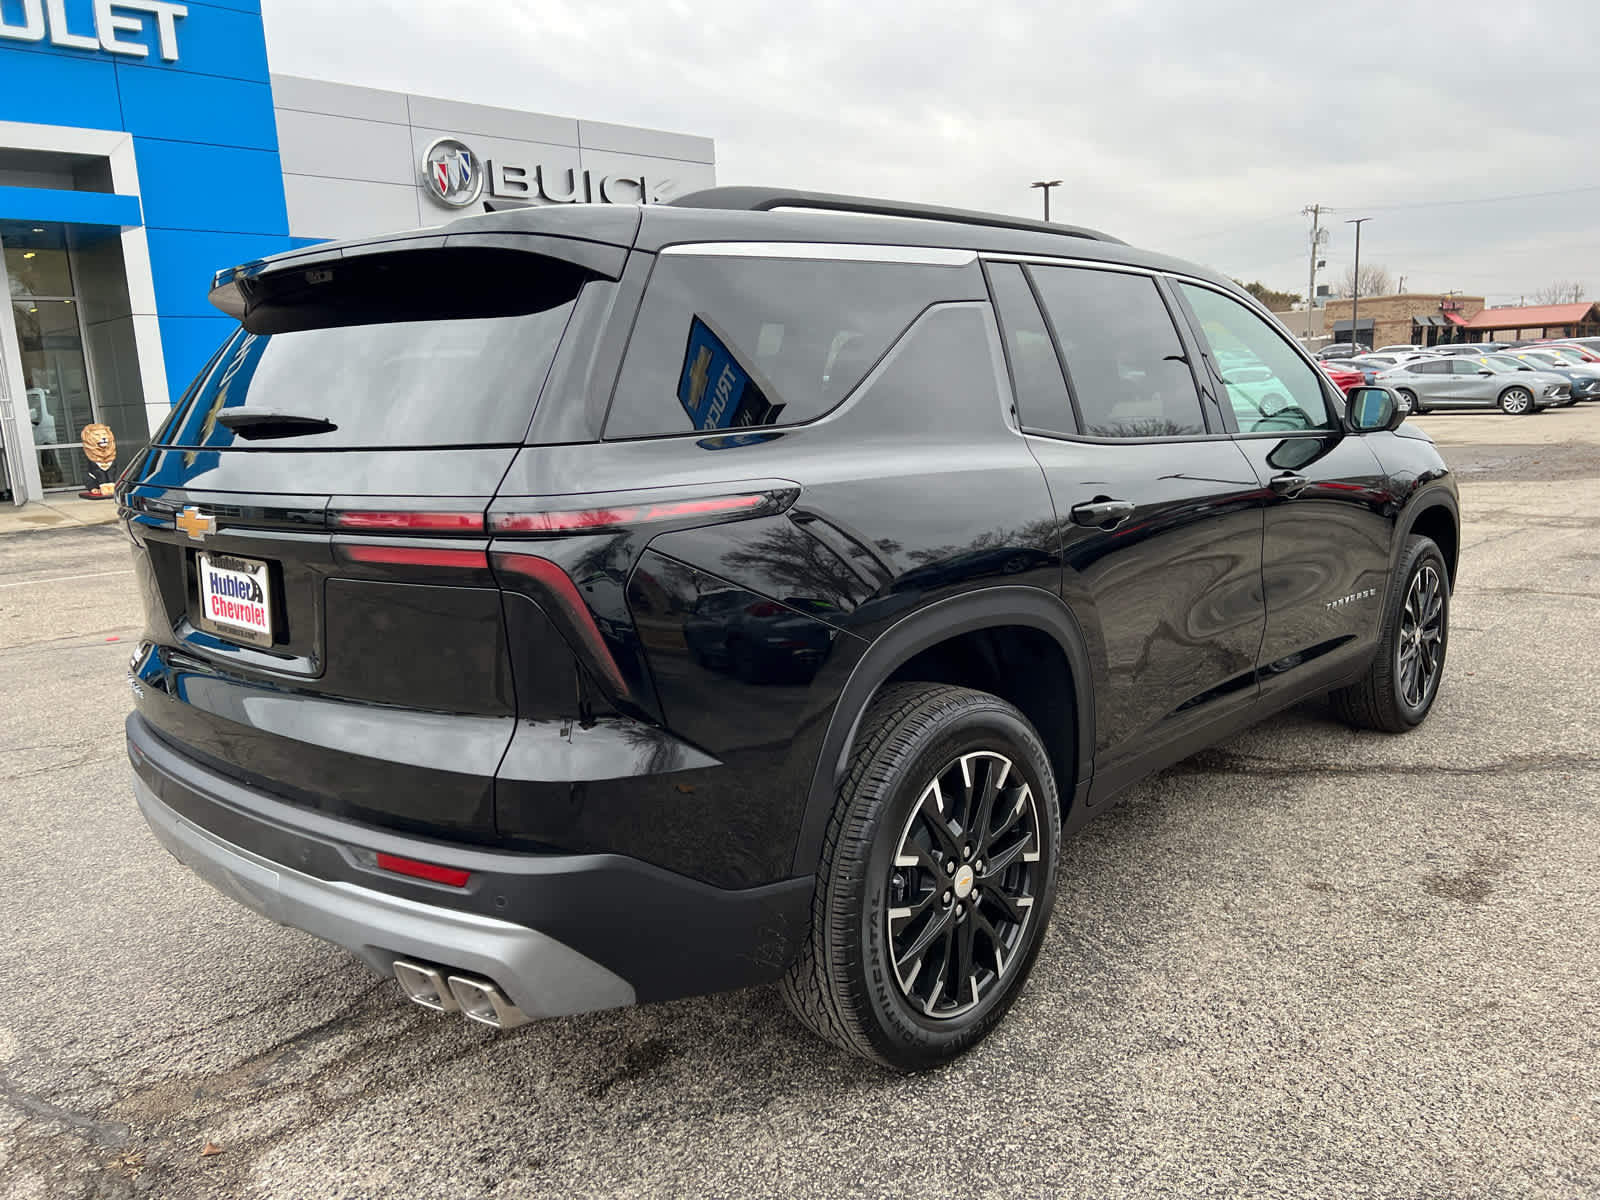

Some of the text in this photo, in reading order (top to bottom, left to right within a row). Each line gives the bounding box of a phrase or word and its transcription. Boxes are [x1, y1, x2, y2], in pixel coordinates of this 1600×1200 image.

[487, 160, 677, 204] BUICK
[210, 572, 250, 600] Hubler
[1326, 588, 1376, 610] TRAVERSE
[211, 595, 266, 627] Chevrolet
